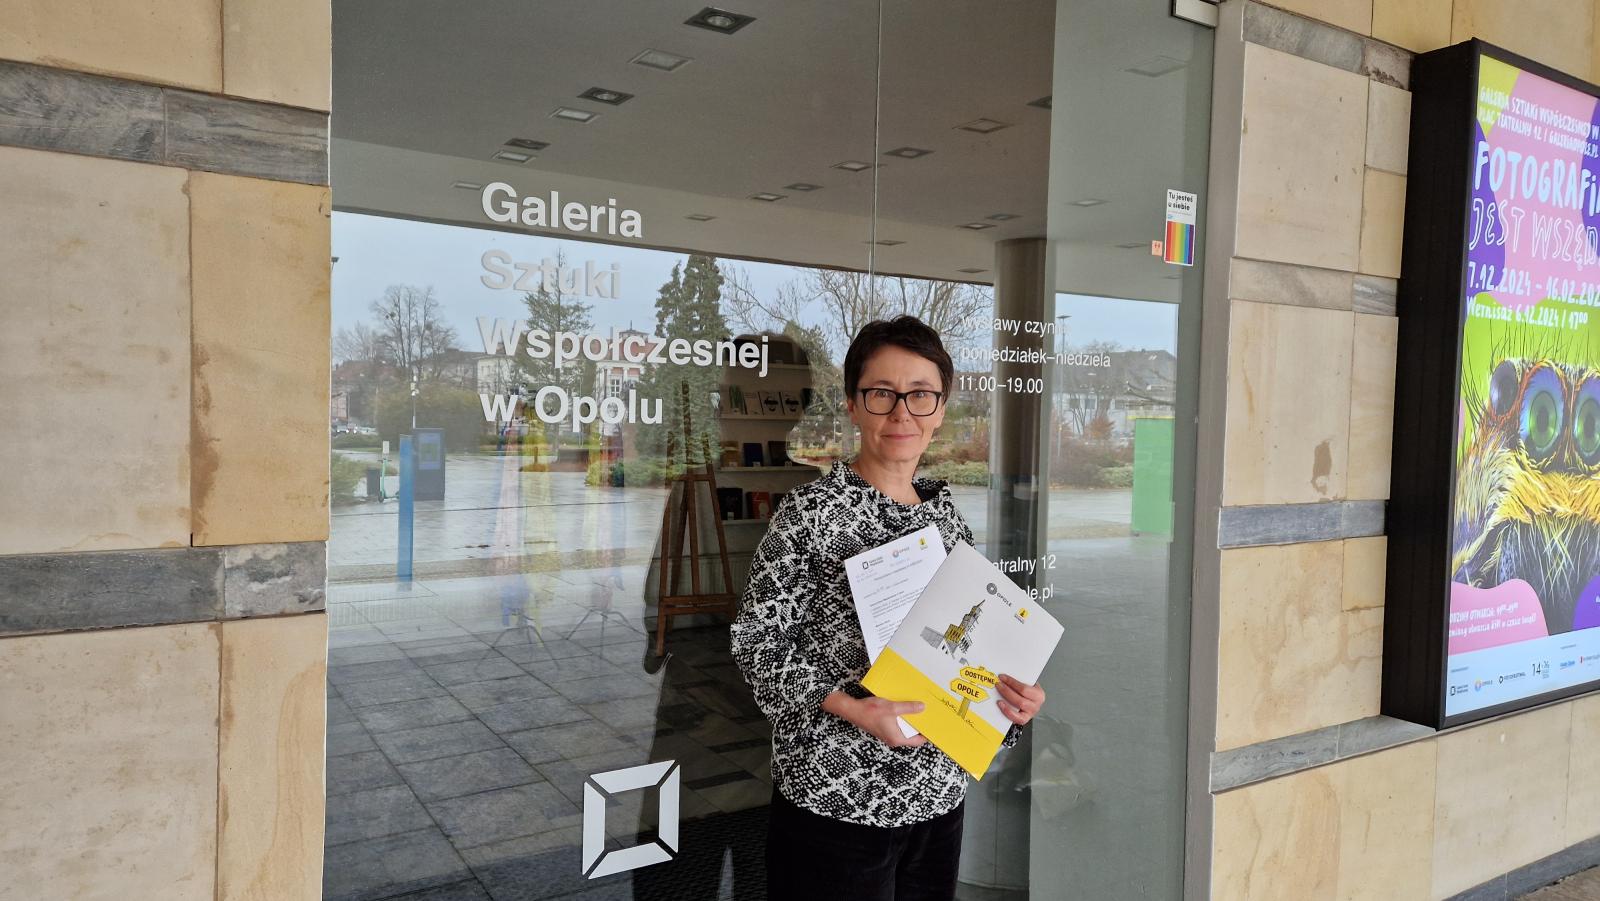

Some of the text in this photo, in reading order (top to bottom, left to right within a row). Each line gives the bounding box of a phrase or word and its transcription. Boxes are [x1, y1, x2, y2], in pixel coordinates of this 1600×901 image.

[482, 182, 643, 238] Galeria
[1168, 191, 1175, 199] Tu
[1172, 202, 1190, 211] siebie
[1469, 198, 1600, 271] JEST WSZĘD
[480, 249, 621, 299] Sztuki
[1468, 261, 1531, 296] 7.12.2024
[1466, 295, 1513, 321] Wernisaż
[476, 317, 768, 377] Współczesnej
[480, 385, 663, 433] w Opolu
[1041, 554, 1056, 569] 12
[1022, 583, 1054, 603] le.pl
[957, 683, 980, 698] OPOLE
